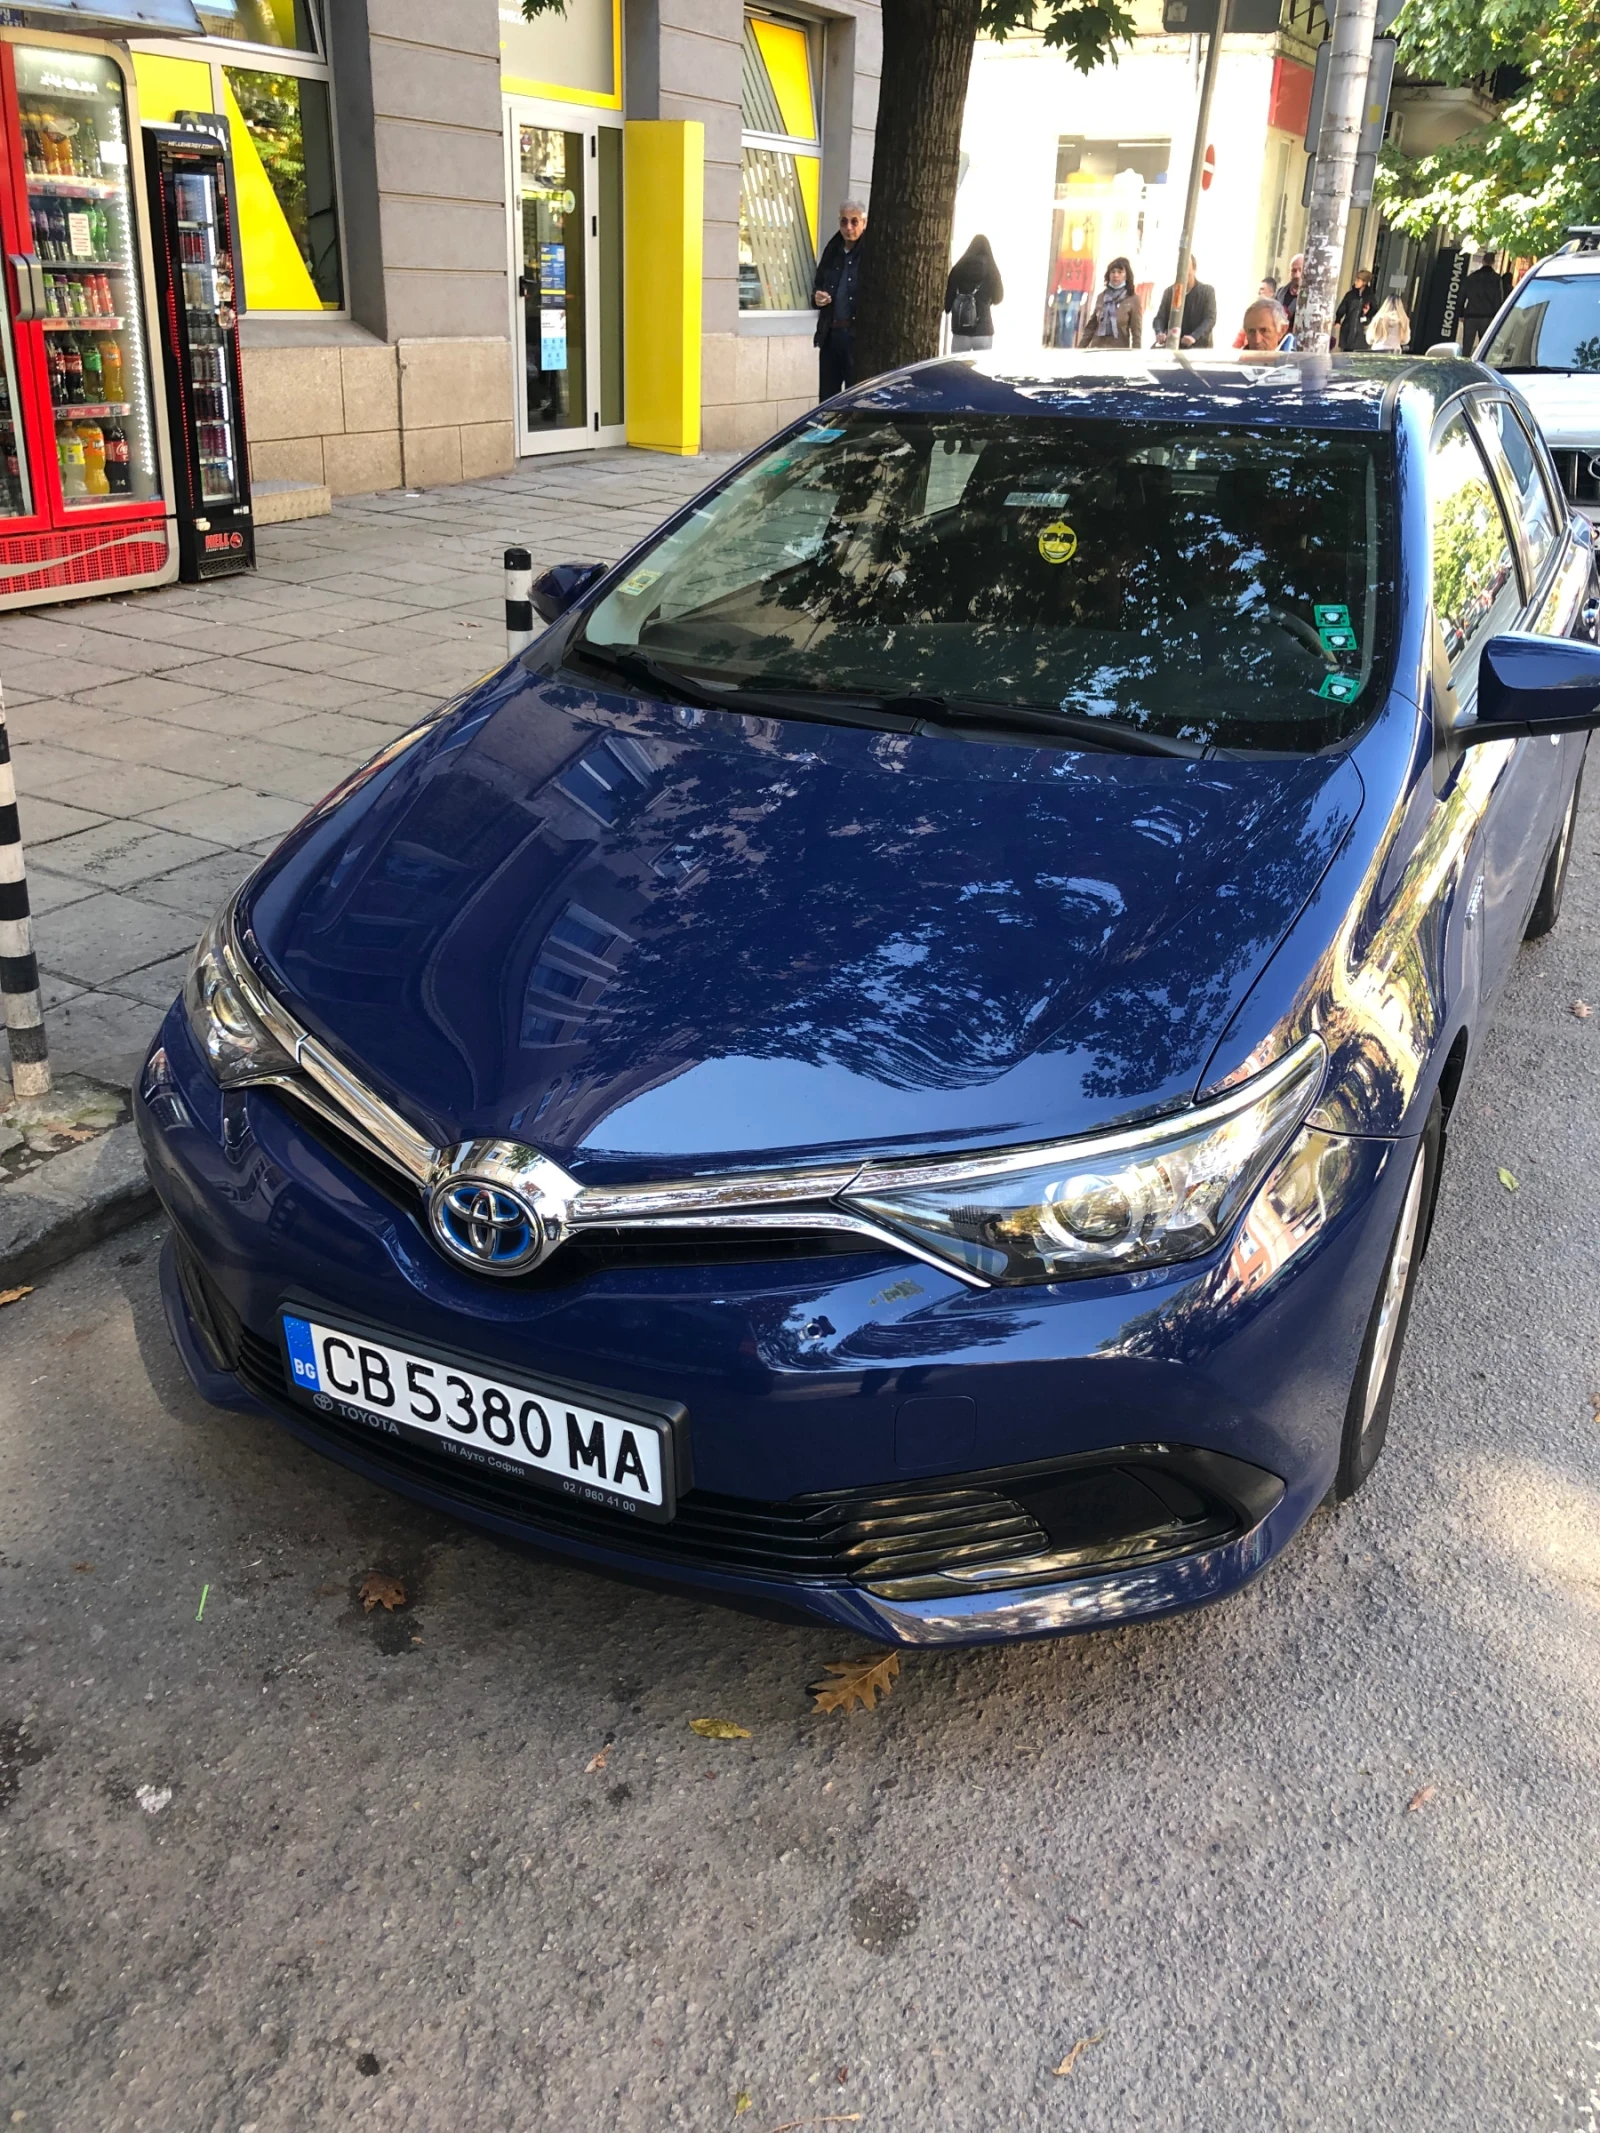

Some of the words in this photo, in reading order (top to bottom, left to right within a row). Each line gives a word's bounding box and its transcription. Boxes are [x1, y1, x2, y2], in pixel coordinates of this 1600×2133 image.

[1440, 253, 1465, 338] ЕКОНТОМАТ
[293, 1357, 317, 1380] BG
[322, 1336, 397, 1408] CB
[405, 1360, 553, 1459] 5380
[565, 1411, 651, 1494] MA
[338, 1403, 400, 1436] TOYOTA
[459, 1447, 486, 1462] Ауто
[487, 1456, 526, 1477] София
[562, 1481, 576, 1493] 02
[584, 1488, 604, 1502] 960
[606, 1496, 620, 1508] 41
[622, 1502, 637, 1513] 00
